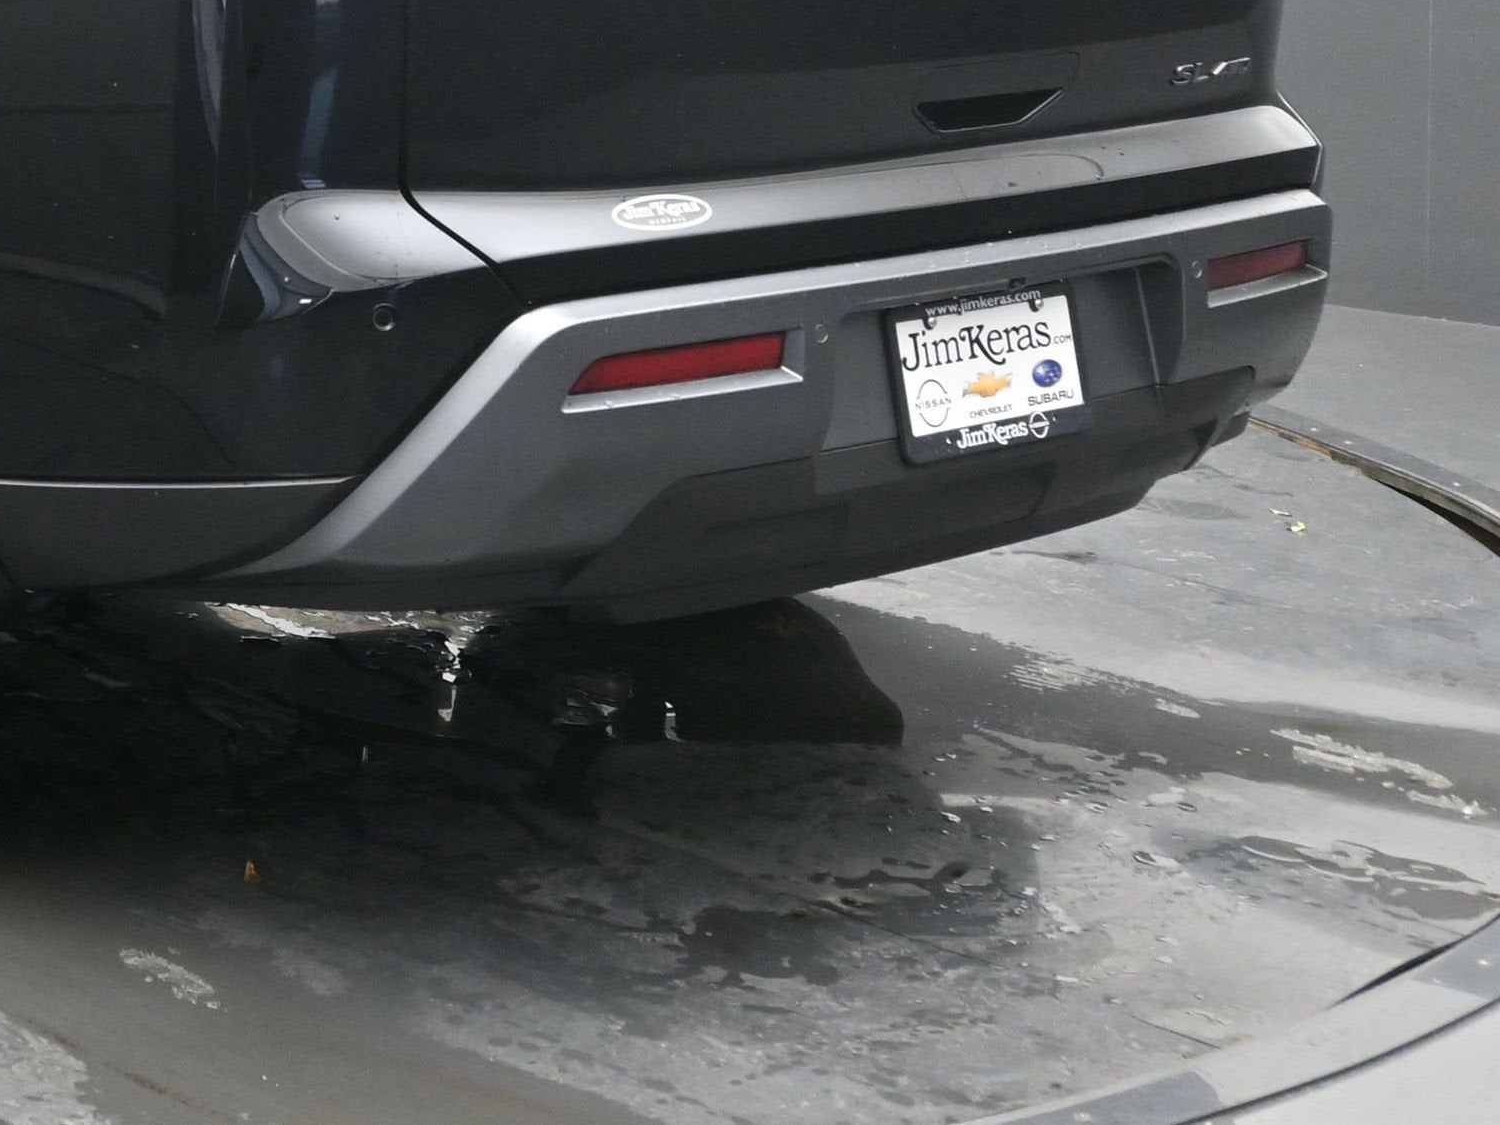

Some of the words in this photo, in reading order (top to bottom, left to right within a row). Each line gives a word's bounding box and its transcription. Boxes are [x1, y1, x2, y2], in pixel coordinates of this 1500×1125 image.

[925, 289, 1041, 316] www.jimkeras.com
[915, 397, 953, 411] NISSAN
[1027, 389, 1075, 407] SUBARU
[969, 403, 1014, 420] CHEVROLET
